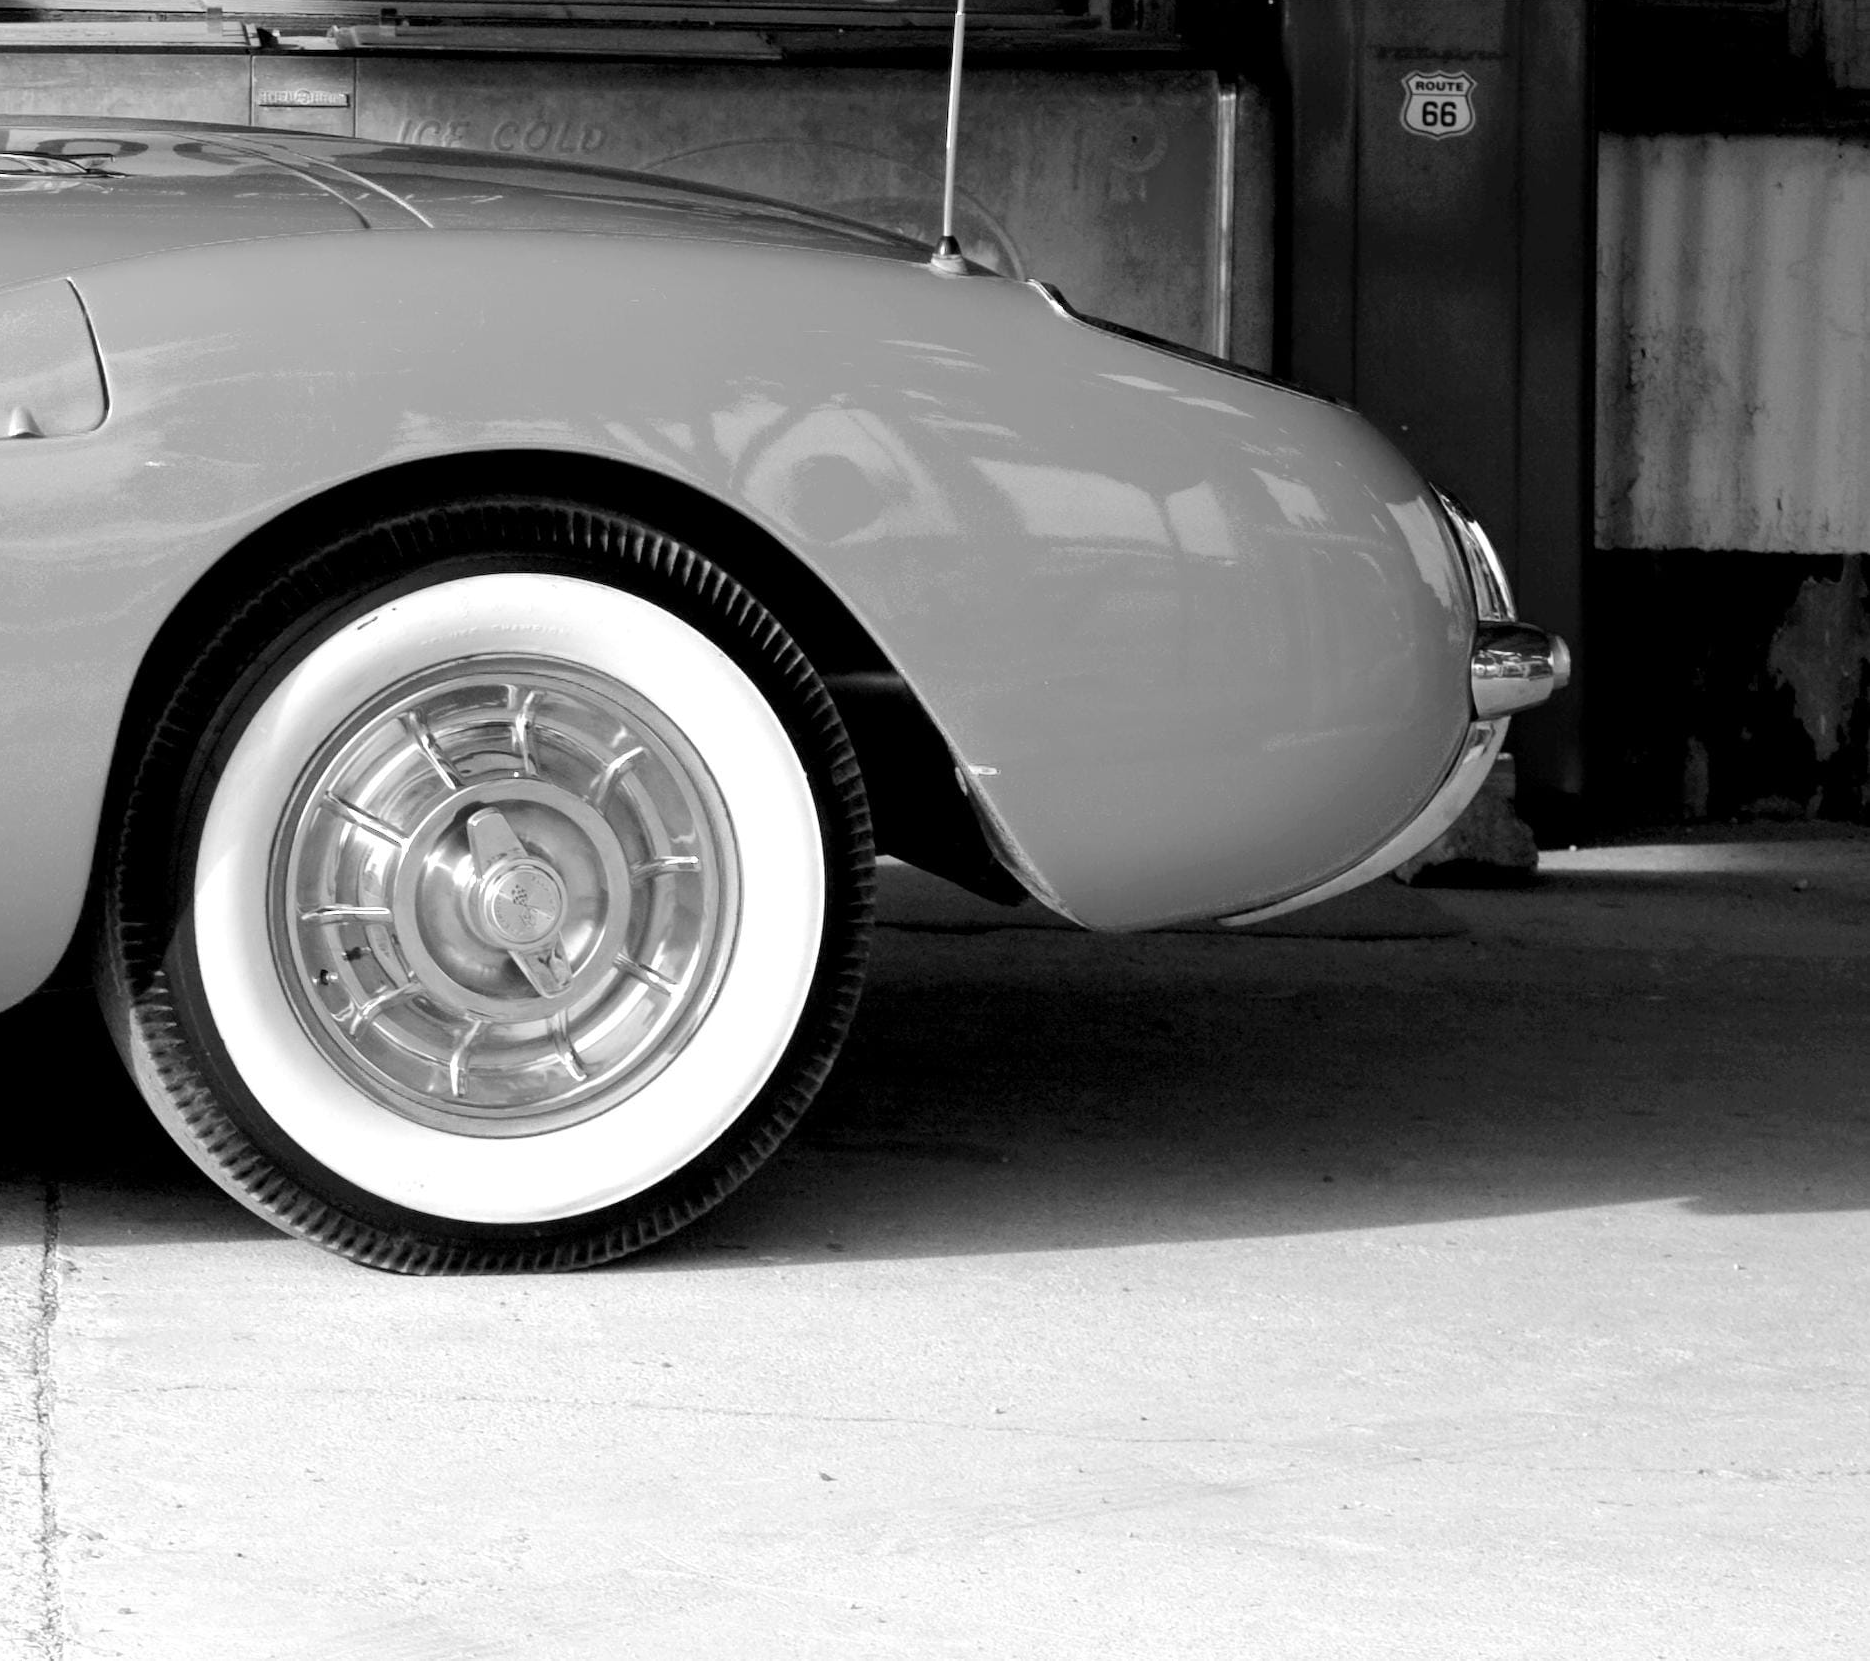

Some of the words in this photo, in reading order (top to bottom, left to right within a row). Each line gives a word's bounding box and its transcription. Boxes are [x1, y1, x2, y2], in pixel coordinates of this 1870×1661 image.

[1414, 80, 1464, 92] ROUTE
[1421, 100, 1458, 127] 66
[491, 119, 608, 154] COLD
